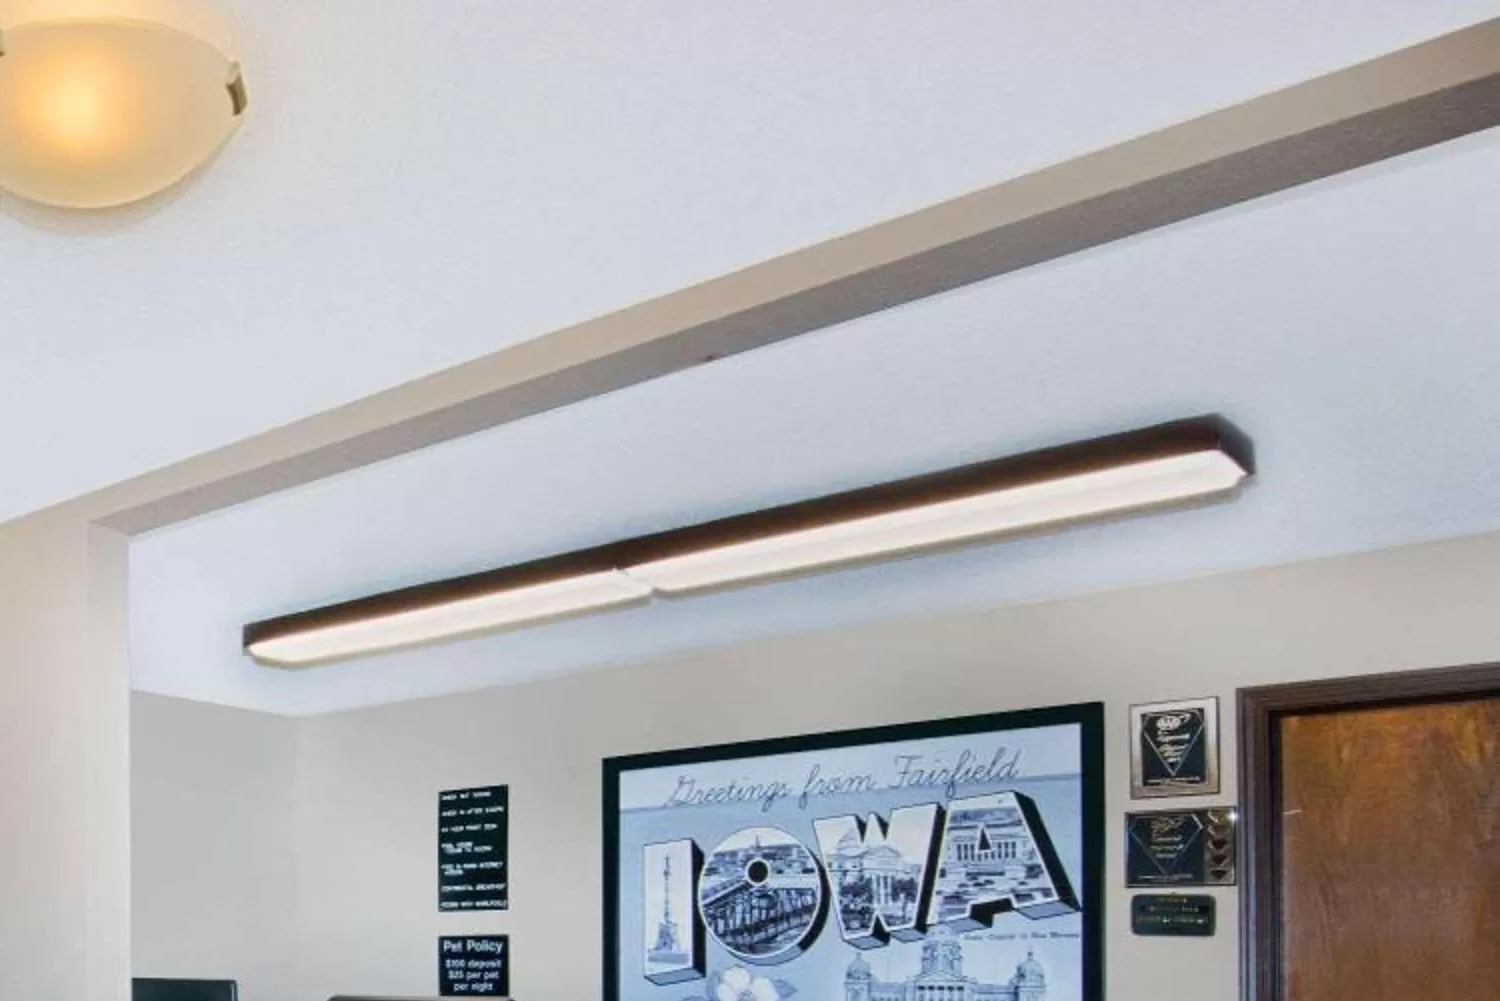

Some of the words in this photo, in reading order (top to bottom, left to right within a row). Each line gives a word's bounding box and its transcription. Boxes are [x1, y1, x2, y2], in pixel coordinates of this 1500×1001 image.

[664, 774, 792, 812] Greetings
[799, 764, 876, 809] from
[888, 748, 1018, 800] Fairfield
[643, 790, 1082, 985] IOWA
[443, 939, 463, 953] Pet
[467, 939, 503, 955] Policy
[467, 959, 502, 970] deposit
[466, 971, 481, 981] per
[453, 983, 469, 992] per
[471, 982, 493, 993] night
